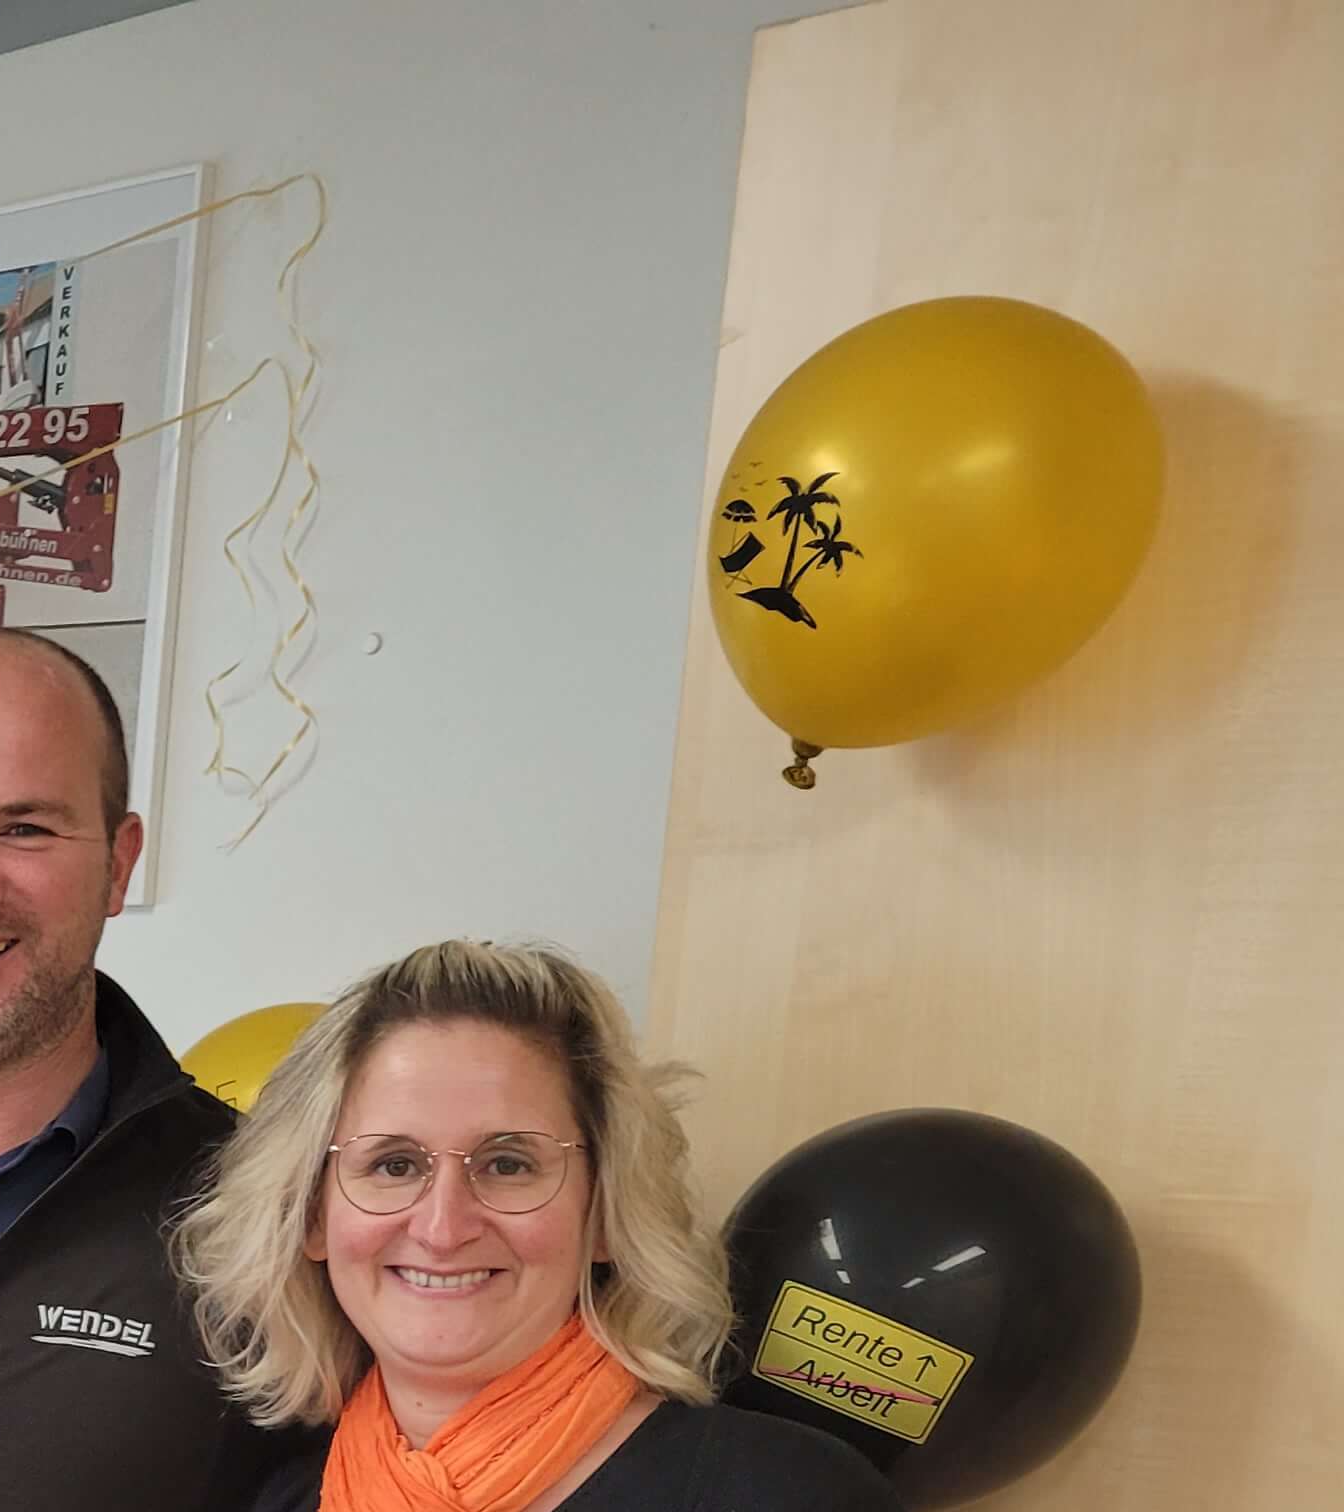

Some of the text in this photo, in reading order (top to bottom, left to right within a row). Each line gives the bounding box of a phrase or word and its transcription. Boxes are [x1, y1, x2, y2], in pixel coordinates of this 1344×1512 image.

[55, 266, 75, 396] VERKAUF
[43, 407, 90, 445] 95
[37, 1304, 156, 1349] WENDEL
[791, 1305, 904, 1368] Rente
[788, 1359, 900, 1418] Arbeit
